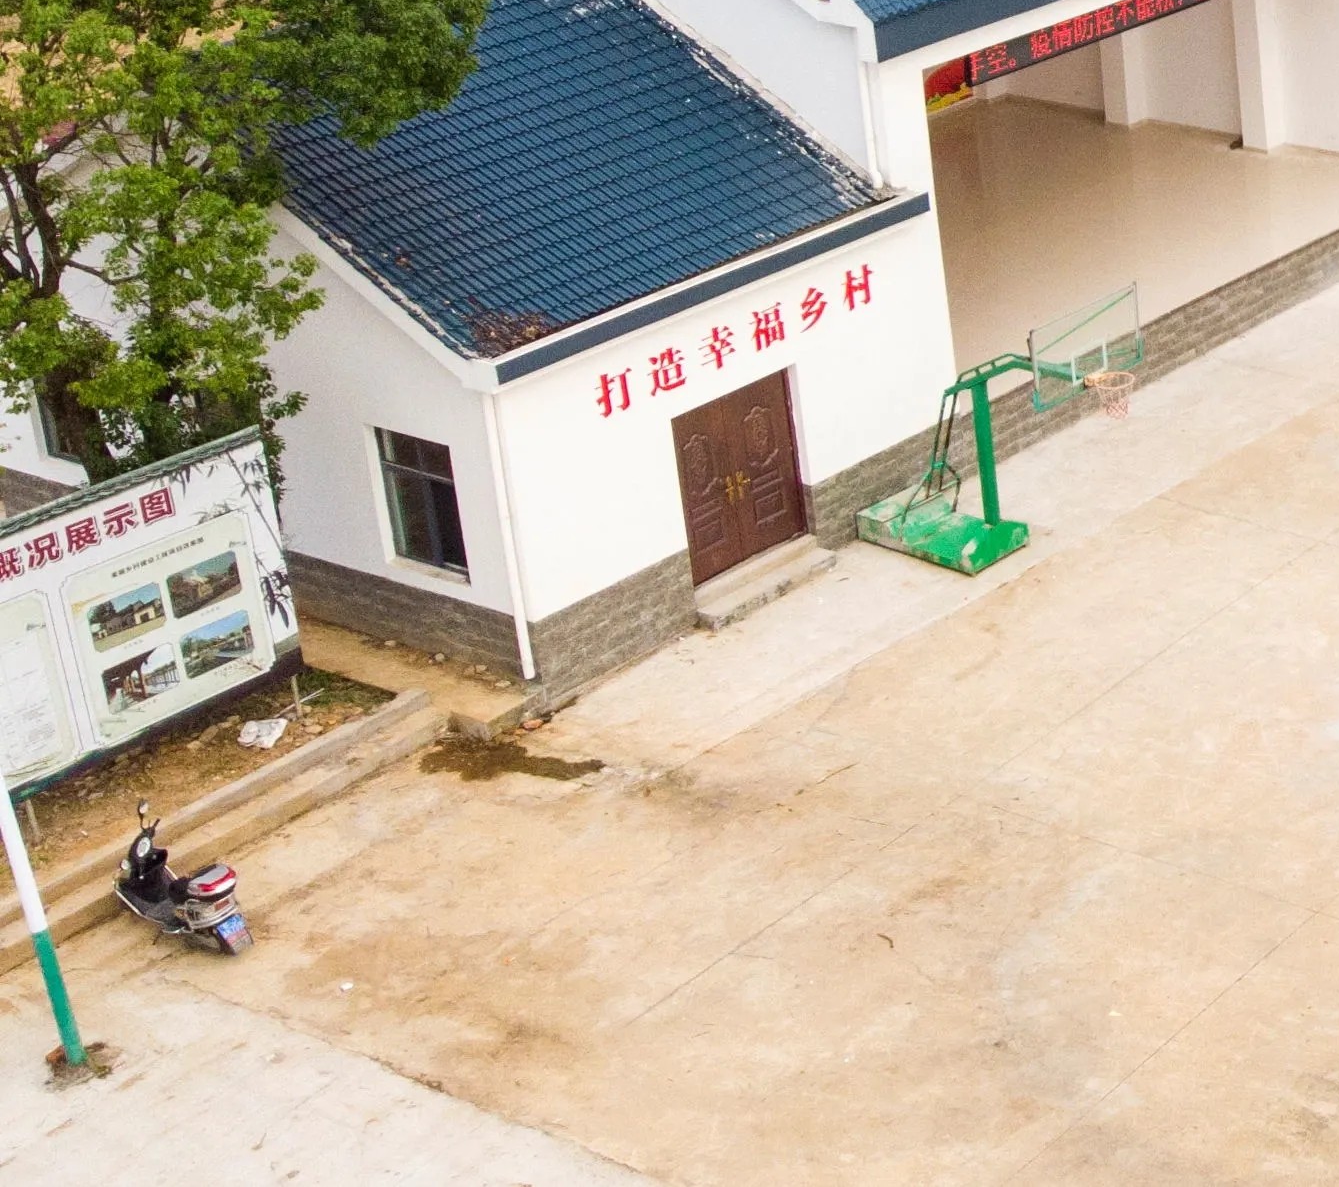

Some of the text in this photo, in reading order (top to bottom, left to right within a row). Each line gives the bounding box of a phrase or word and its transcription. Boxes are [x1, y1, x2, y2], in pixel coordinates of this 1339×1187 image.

[594, 264, 873, 418] 打造幸福乡村
